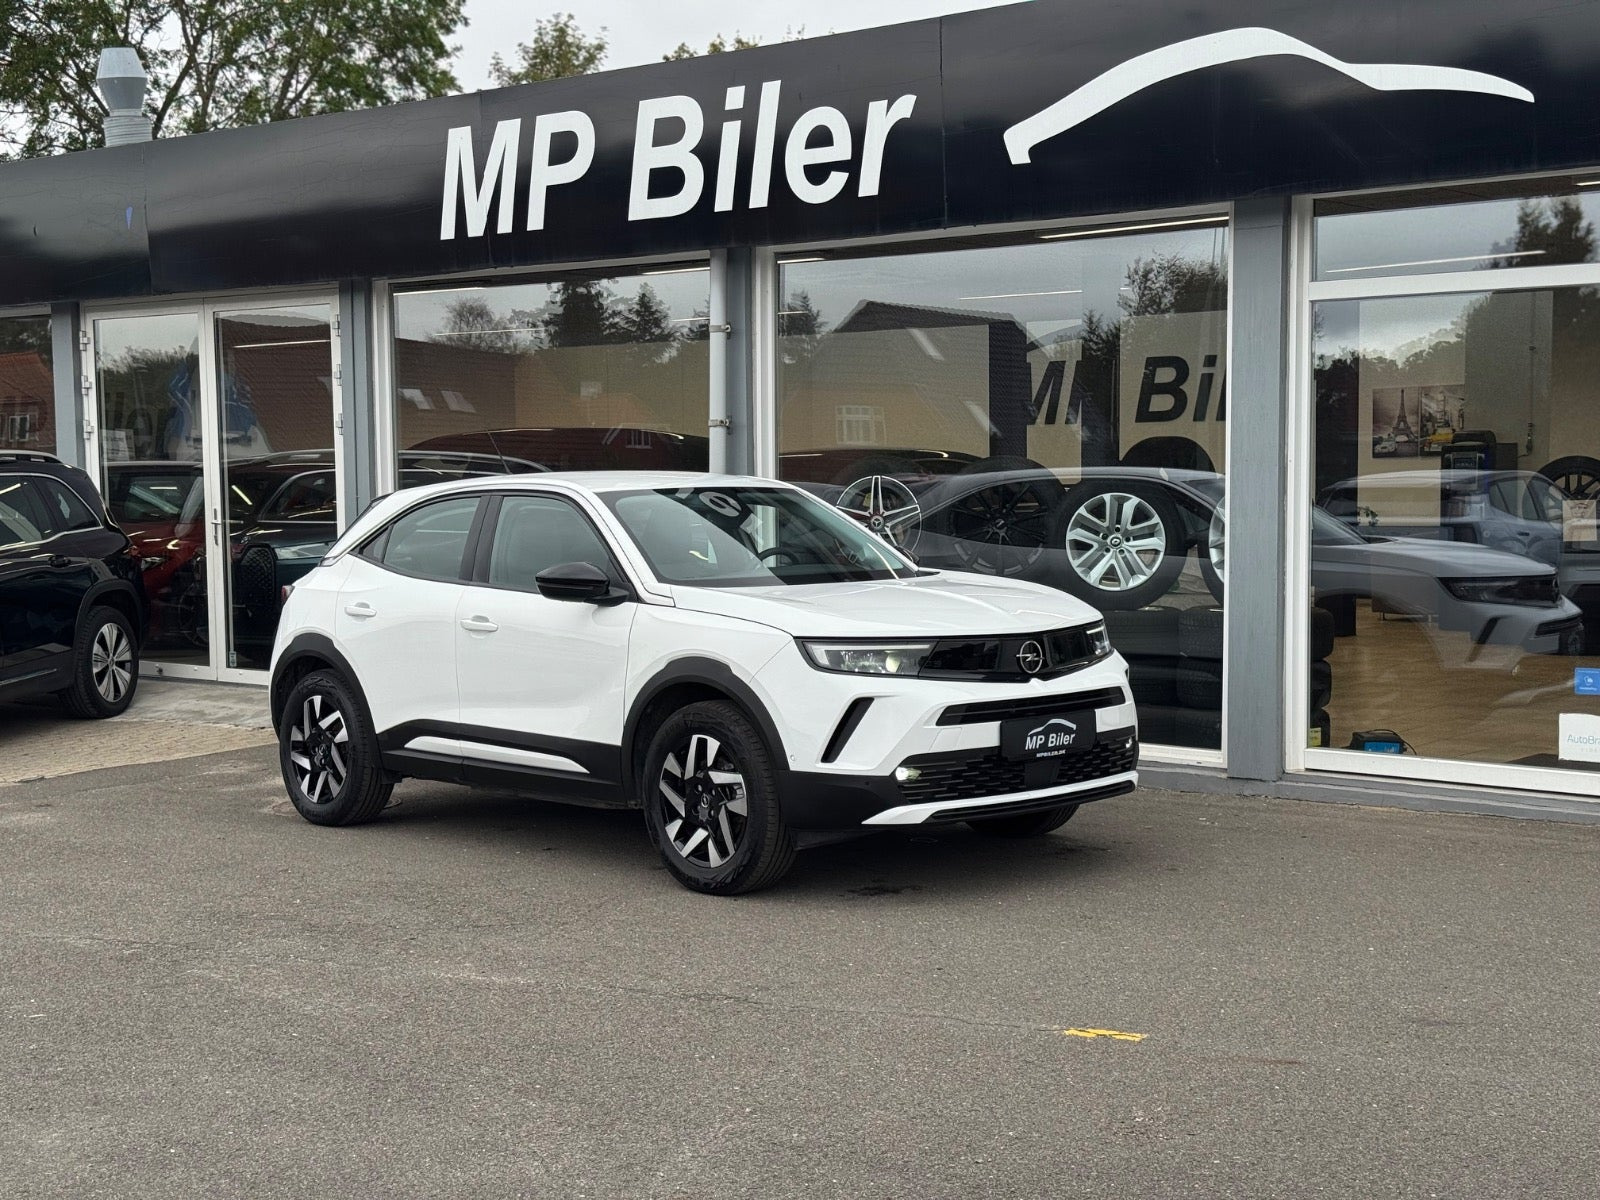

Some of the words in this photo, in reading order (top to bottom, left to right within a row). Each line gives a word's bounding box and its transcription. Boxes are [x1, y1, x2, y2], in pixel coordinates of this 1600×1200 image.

[440, 111, 596, 241] MP
[627, 80, 917, 221] Biler
[1025, 735, 1045, 750] MP
[1048, 732, 1076, 747] Biler
